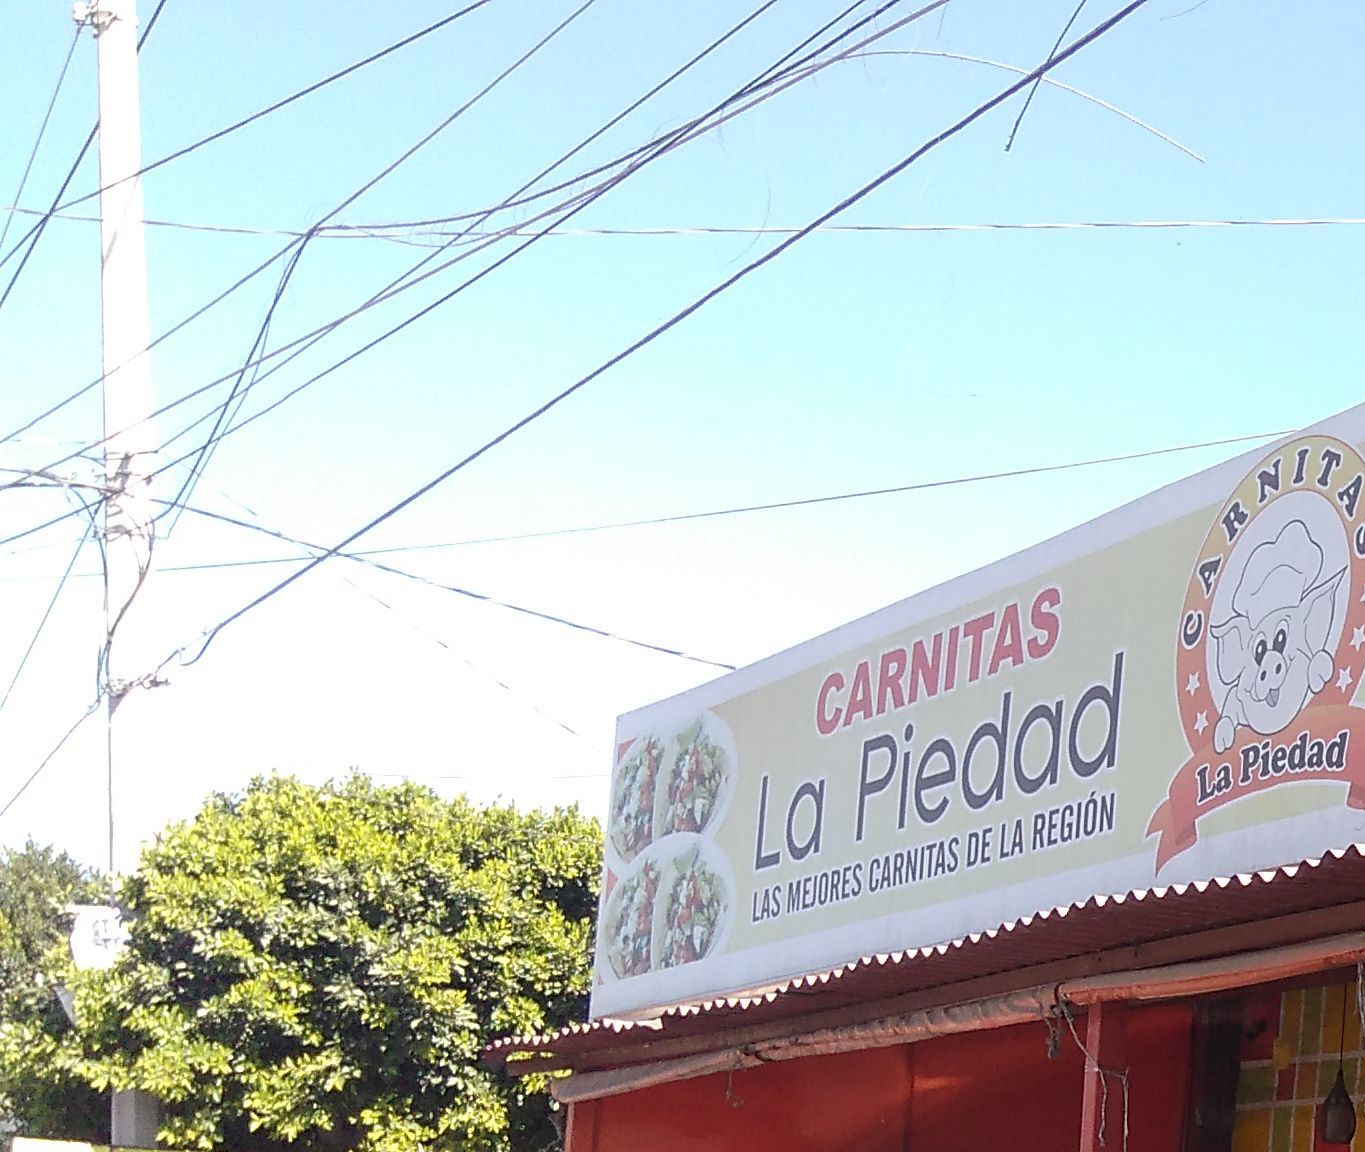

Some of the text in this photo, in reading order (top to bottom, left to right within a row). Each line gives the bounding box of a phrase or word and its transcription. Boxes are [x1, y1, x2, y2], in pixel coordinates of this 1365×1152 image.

[815, 587, 1062, 735] CARNITAS
[755, 651, 1125, 870] La Piedad
[1197, 732, 1347, 802] La Piedad
[752, 792, 1115, 923] LAS MEJORES CARNITAS DE LA REGIÓN
